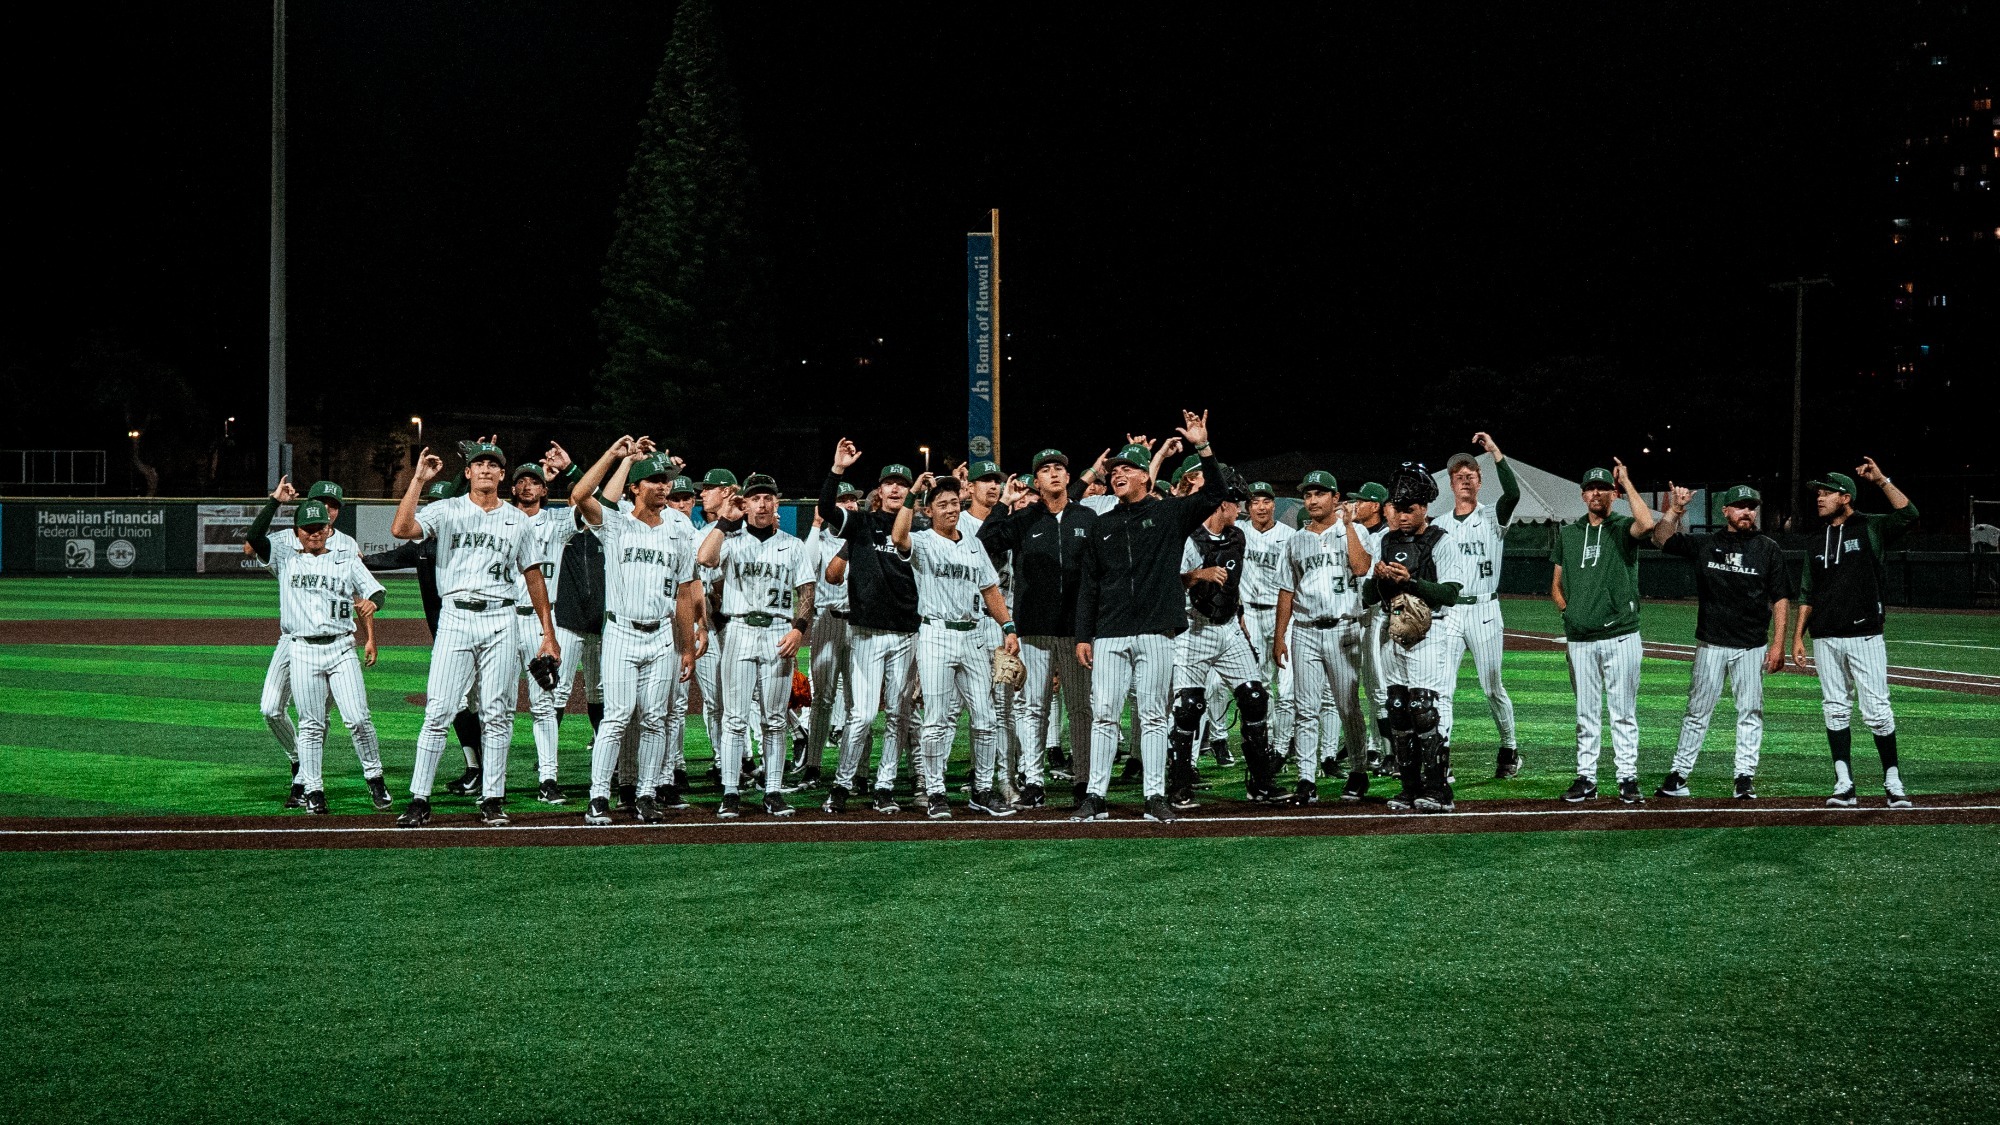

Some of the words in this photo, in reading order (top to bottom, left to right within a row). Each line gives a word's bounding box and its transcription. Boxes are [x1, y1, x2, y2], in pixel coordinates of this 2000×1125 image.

[976, 314, 990, 332] of
[976, 333, 990, 374] Bank
[38, 510, 101, 524] Hawaiian
[104, 510, 164, 524] Financial
[38, 525, 78, 537] Federal
[82, 525, 115, 537] Credit
[118, 526, 151, 537] Union
[364, 543, 388, 551] First
[1477, 560, 1493, 579] 19
[1707, 562, 1759, 575] BASEBALL
[1332, 575, 1360, 595] 34
[767, 588, 792, 609] 25
[329, 599, 350, 619] 18
